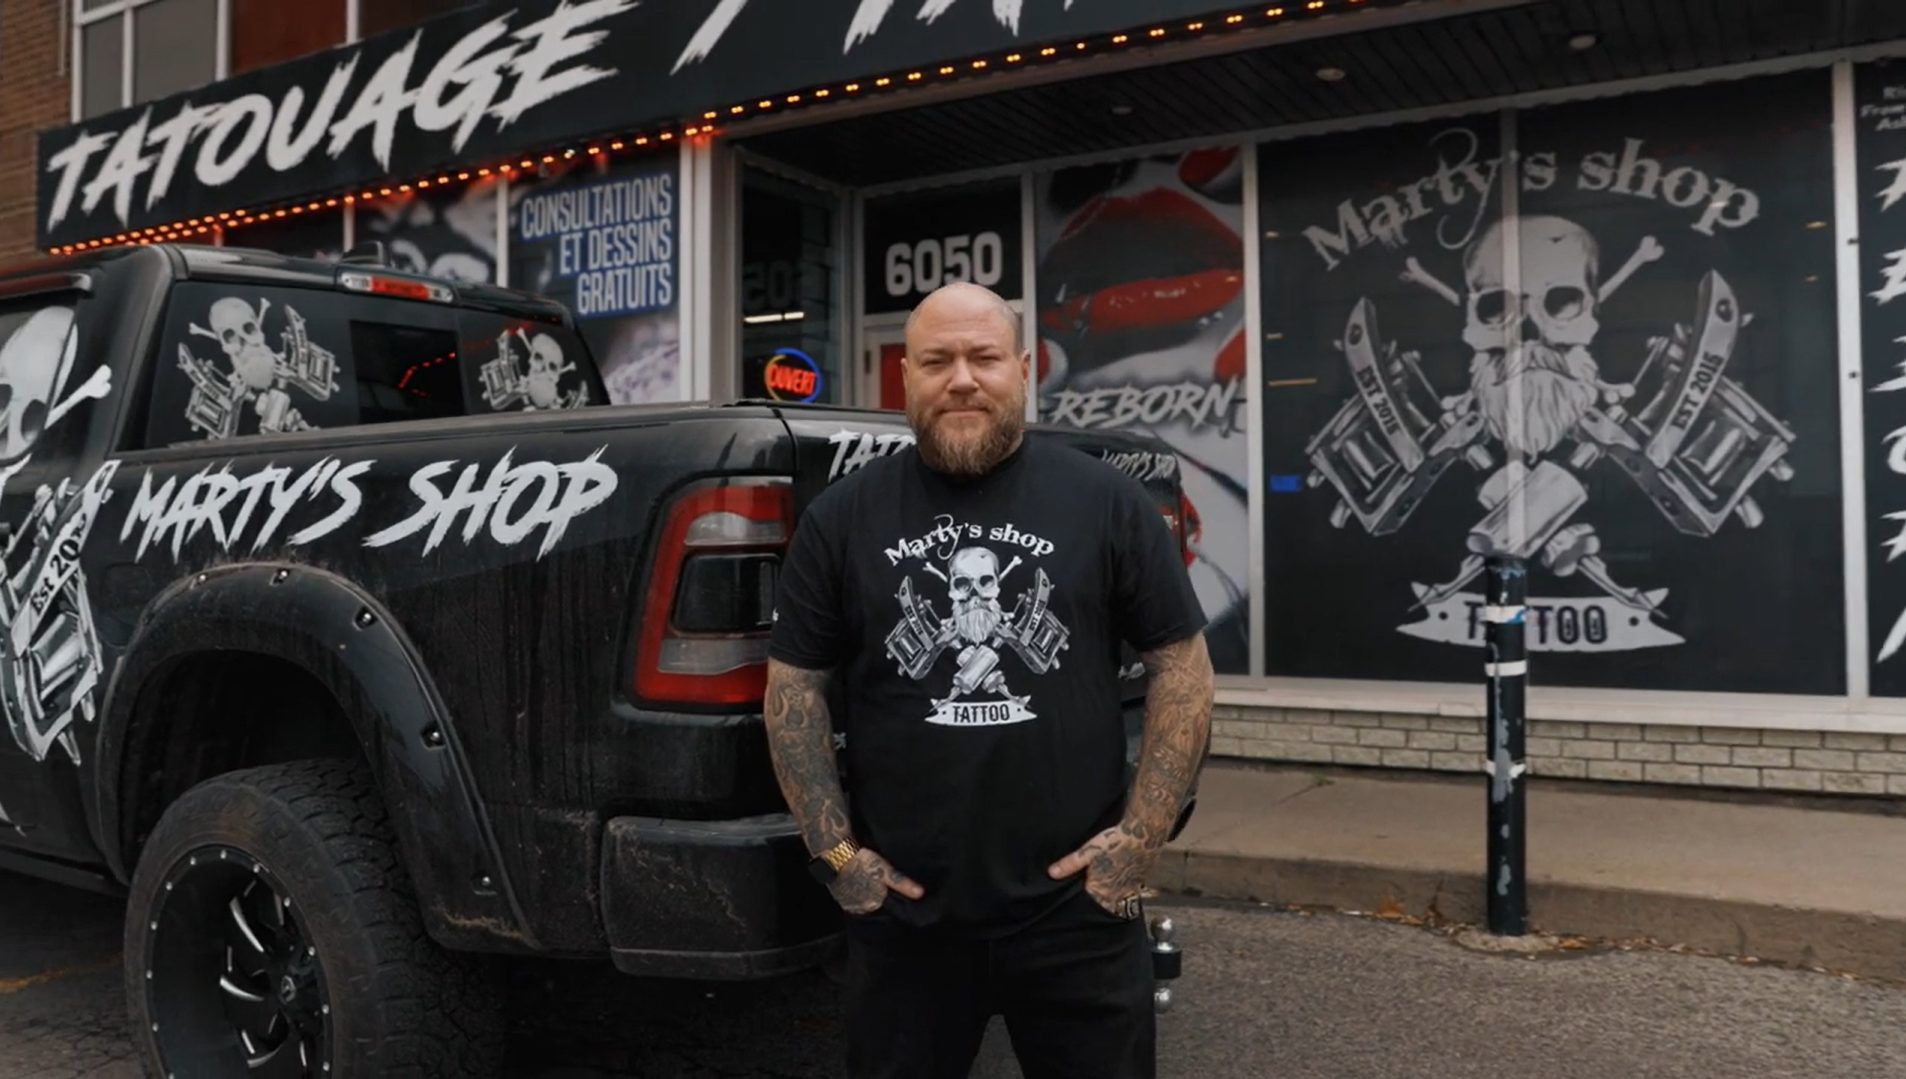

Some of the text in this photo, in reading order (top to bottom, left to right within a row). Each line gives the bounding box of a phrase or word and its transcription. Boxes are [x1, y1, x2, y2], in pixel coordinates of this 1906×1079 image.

[46, 0, 640, 233] TATOUAGE
[521, 173, 672, 239] CONSULTATIONS
[1301, 128, 1760, 271] Marty's shop
[560, 217, 672, 275] ET DESSINS
[885, 231, 1003, 297] 6050
[577, 262, 672, 316] GRATUITS
[767, 363, 817, 395] OUVERT
[1050, 375, 1238, 430] REBORN
[1669, 351, 1725, 431] EST 2015
[119, 443, 618, 565] MARTY'S SHOP
[884, 513, 1055, 566] Marty's shop
[30, 576, 55, 617] Est
[1464, 601, 1608, 645] TTOO
[953, 704, 1010, 723] TATTOO
